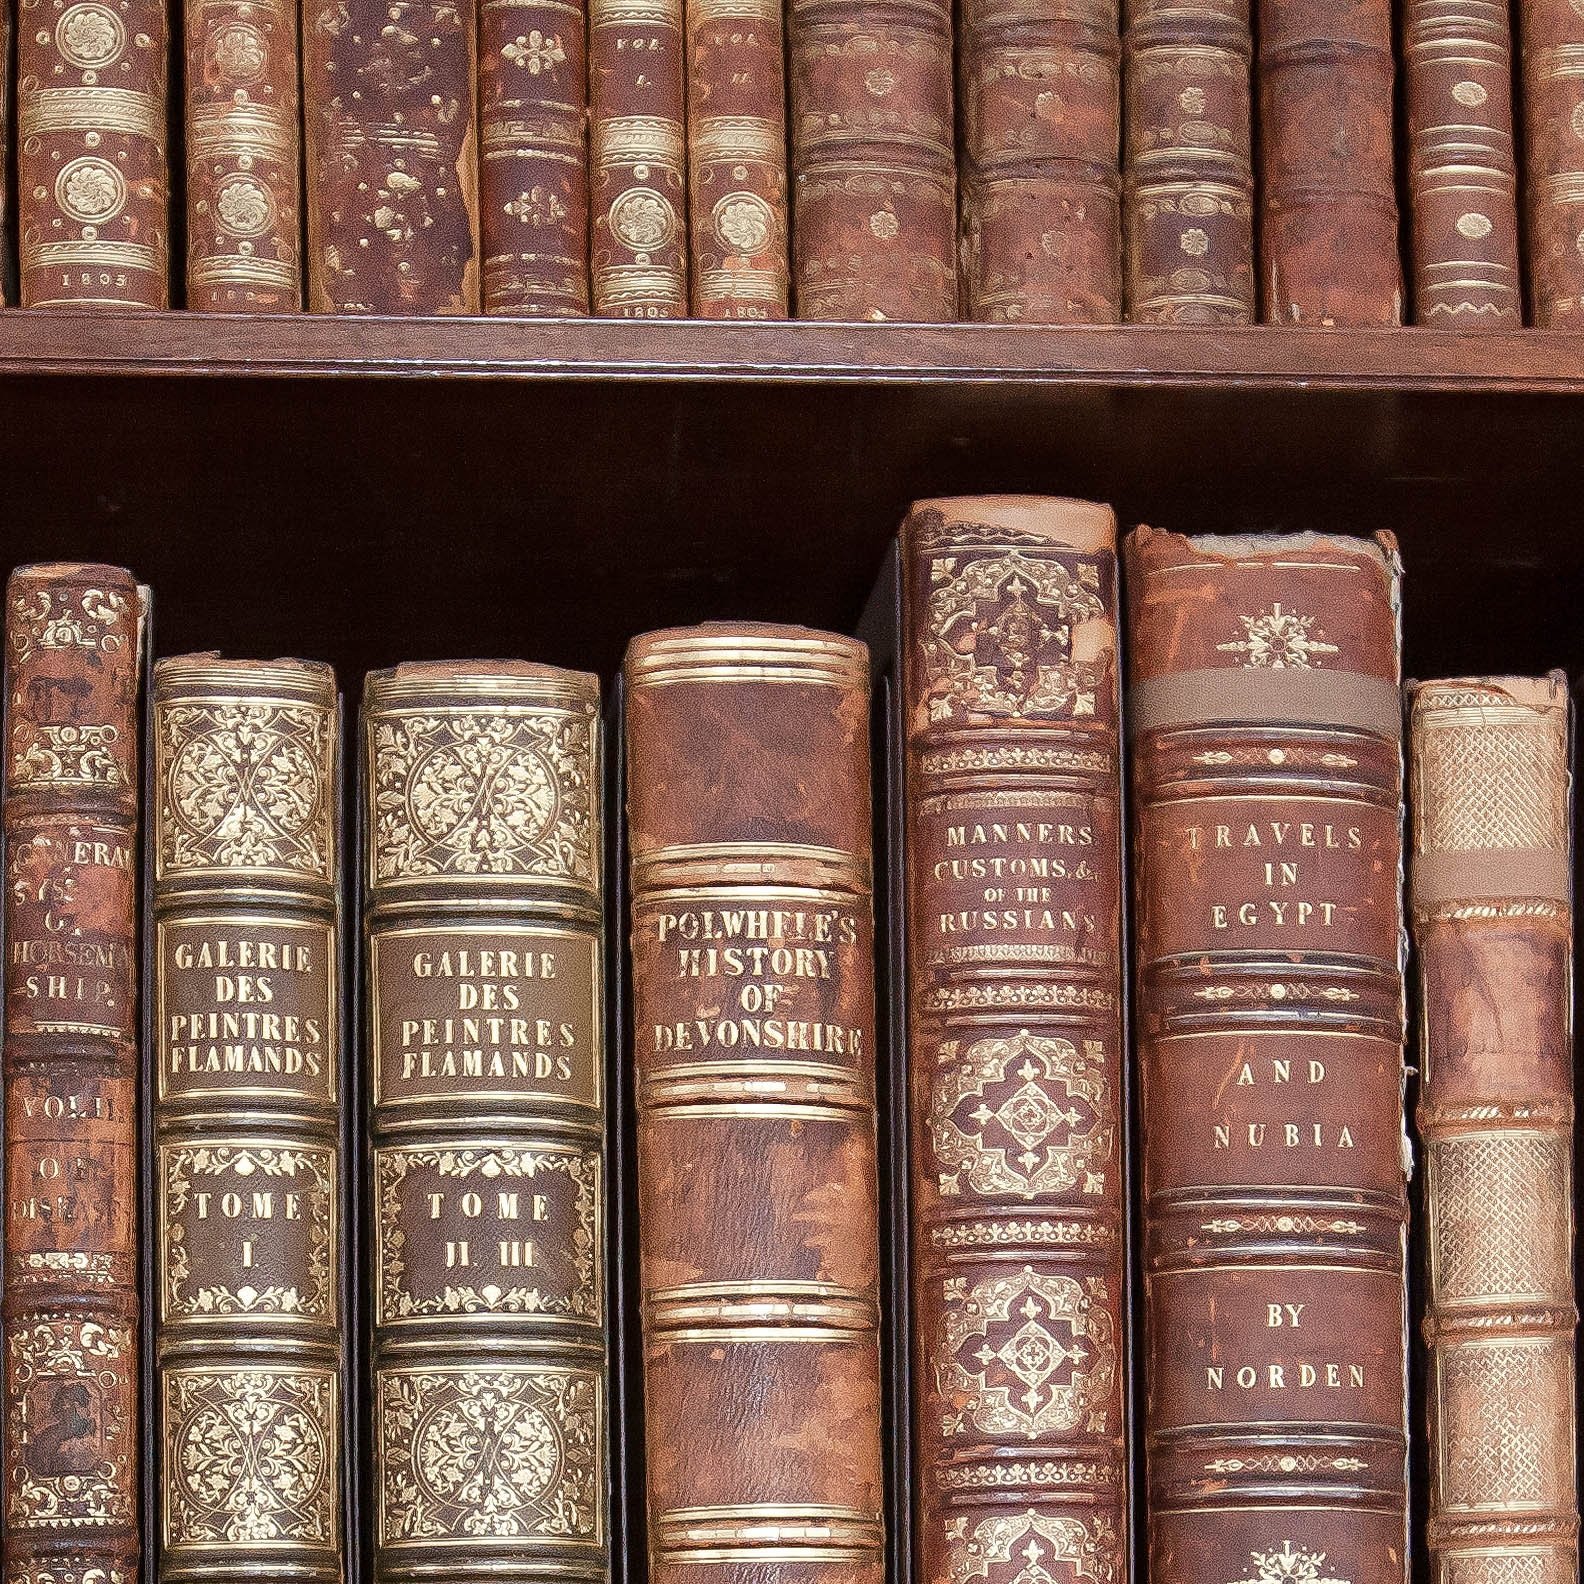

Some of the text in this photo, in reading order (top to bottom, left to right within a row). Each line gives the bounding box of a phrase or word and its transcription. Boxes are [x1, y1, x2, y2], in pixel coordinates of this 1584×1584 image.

[948, 824, 1092, 846] MANNERS
[1186, 824, 1362, 848] TRAVELS
[1265, 863, 1298, 885] IN
[984, 887, 1050, 902] OF THE
[940, 910, 1094, 932] RUSSIANS
[1213, 902, 1336, 927] EGYPT
[657, 911, 856, 946] POLWHELE'S
[175, 942, 311, 974] GALERIE
[414, 951, 555, 978] GALERIE
[678, 948, 833, 978] HISTORY
[216, 976, 272, 1002] DES
[460, 984, 519, 1010] DES
[742, 985, 781, 1011] OF
[172, 1013, 320, 1042] PEINTRES
[402, 1019, 574, 1046] PEINTRES
[654, 1021, 862, 1052] DEVONSHIRE
[172, 1046, 320, 1077] FLAMANDS
[402, 1052, 572, 1078] FLAMANDS
[1238, 1060, 1325, 1084] AND
[1215, 1124, 1354, 1148] NUBIA
[197, 1192, 300, 1220] TOME
[428, 1193, 548, 1220] TOME
[1268, 1304, 1302, 1327] BY
[1208, 1366, 1364, 1388] NORDEN
